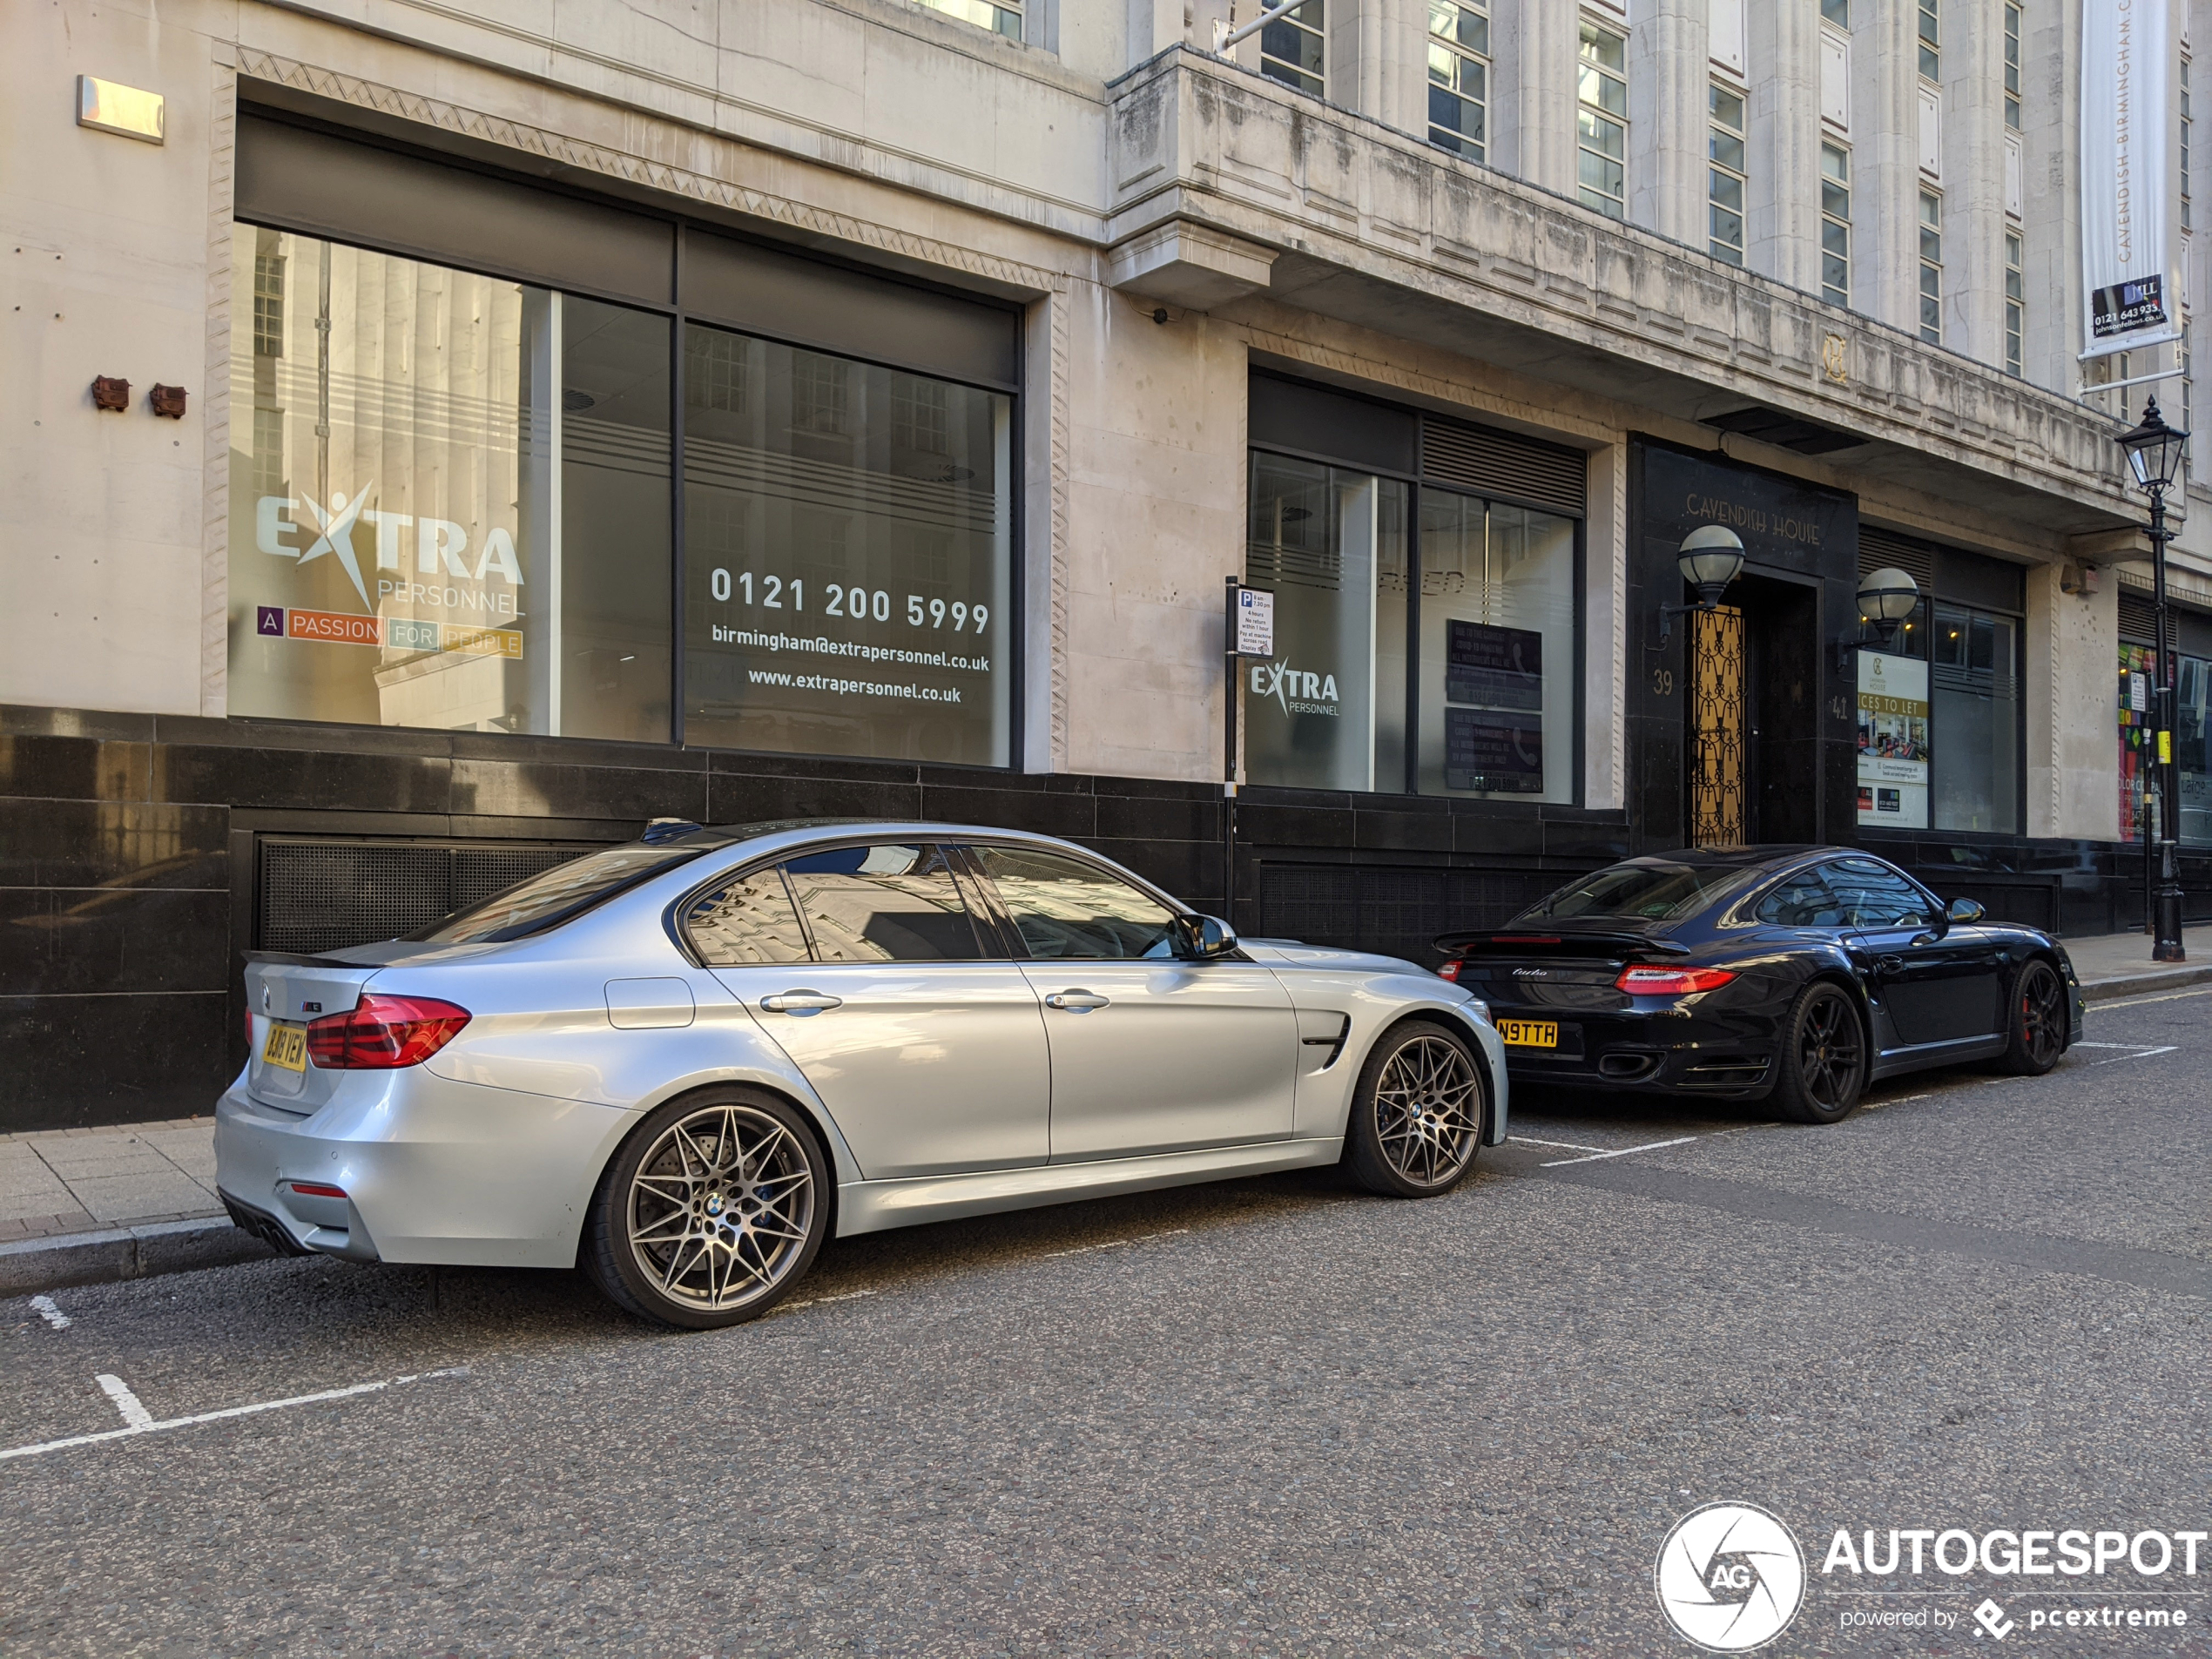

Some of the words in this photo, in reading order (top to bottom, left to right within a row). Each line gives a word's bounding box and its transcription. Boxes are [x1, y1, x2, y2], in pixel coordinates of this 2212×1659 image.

[2095, 313, 2117, 326] 0121
[2121, 308, 2138, 320] 643
[1686, 493, 1767, 533] CAVENDISH
[1773, 515, 1820, 546] HOUSE
[256, 478, 525, 615] EXTRA
[378, 579, 526, 616] PERSONNEL
[711, 568, 803, 611] 0121
[826, 583, 890, 622] 200
[907, 595, 989, 634] 5999
[1243, 593, 1251, 606] P
[263, 613, 278, 631] A
[293, 615, 381, 640] PASSION
[395, 626, 433, 644] FOR
[446, 631, 519, 653] PEOPLE
[711, 624, 990, 671] birmingham@extrapersonnel.co.uk
[748, 669, 961, 703] www.extrapersonnel.co.uk
[1251, 656, 1339, 718] EXTRA
[1653, 669, 1673, 696] 39
[1869, 683, 1886, 691] HOUSE
[1289, 701, 1339, 716] PERSONNEL
[1833, 695, 1848, 720] 41
[1885, 698, 1897, 712] TO
[1902, 701, 1917, 715] LET
[1512, 968, 1548, 976] turbo
